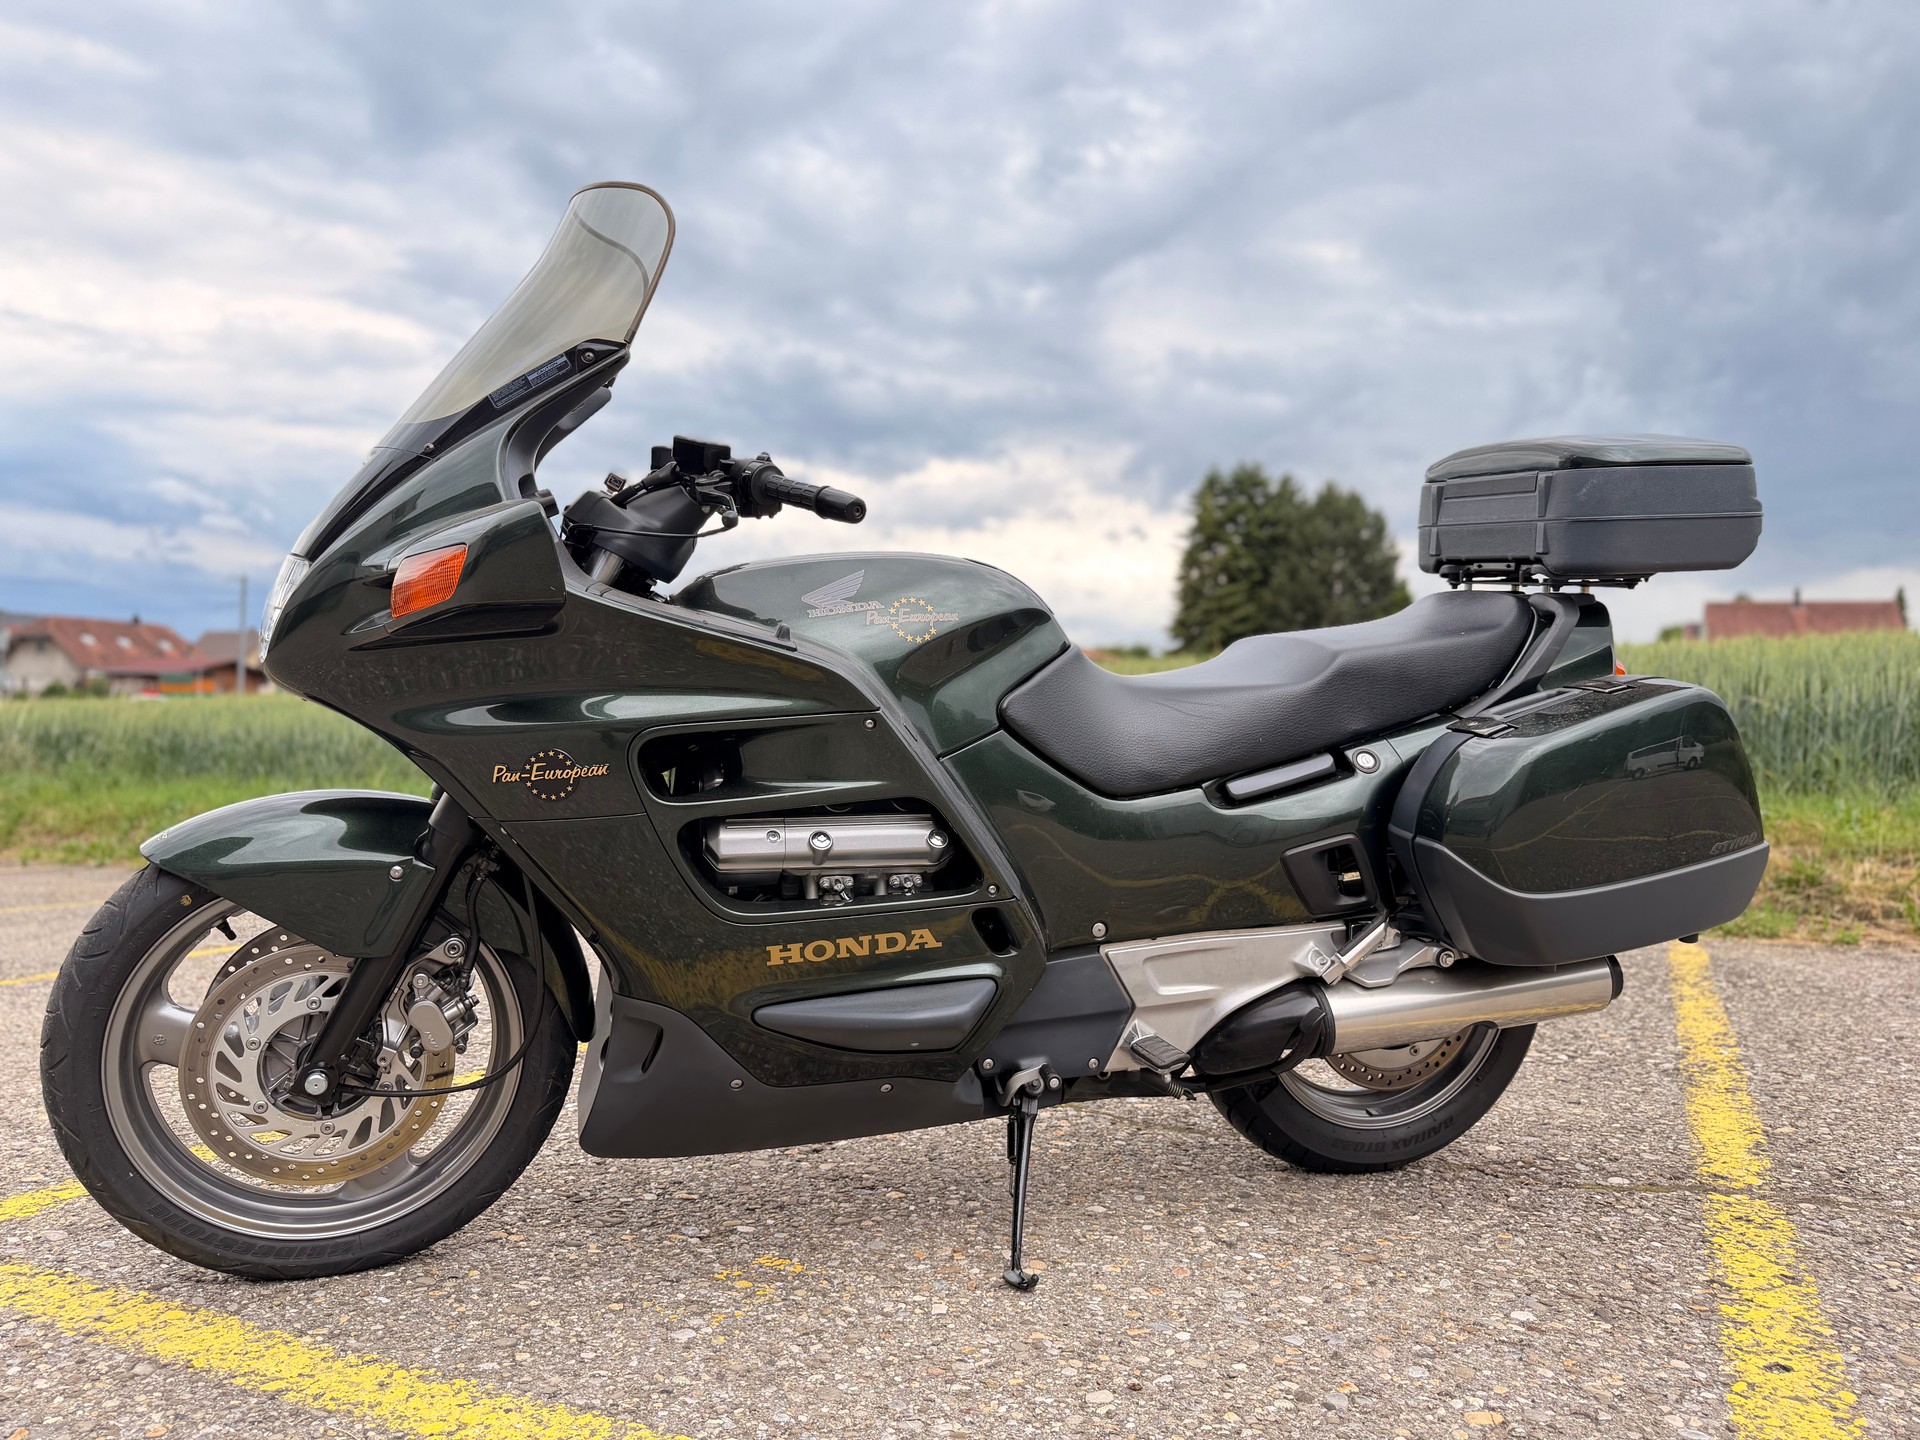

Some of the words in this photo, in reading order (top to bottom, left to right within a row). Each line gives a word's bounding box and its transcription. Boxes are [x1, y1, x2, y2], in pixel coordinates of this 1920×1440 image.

[807, 601, 885, 618] HONDA
[866, 608, 960, 626] Pan-European
[492, 762, 610, 784] Pan-European
[766, 928, 942, 966] HONDA
[146, 1203, 357, 1261] BRIDGESTONE
